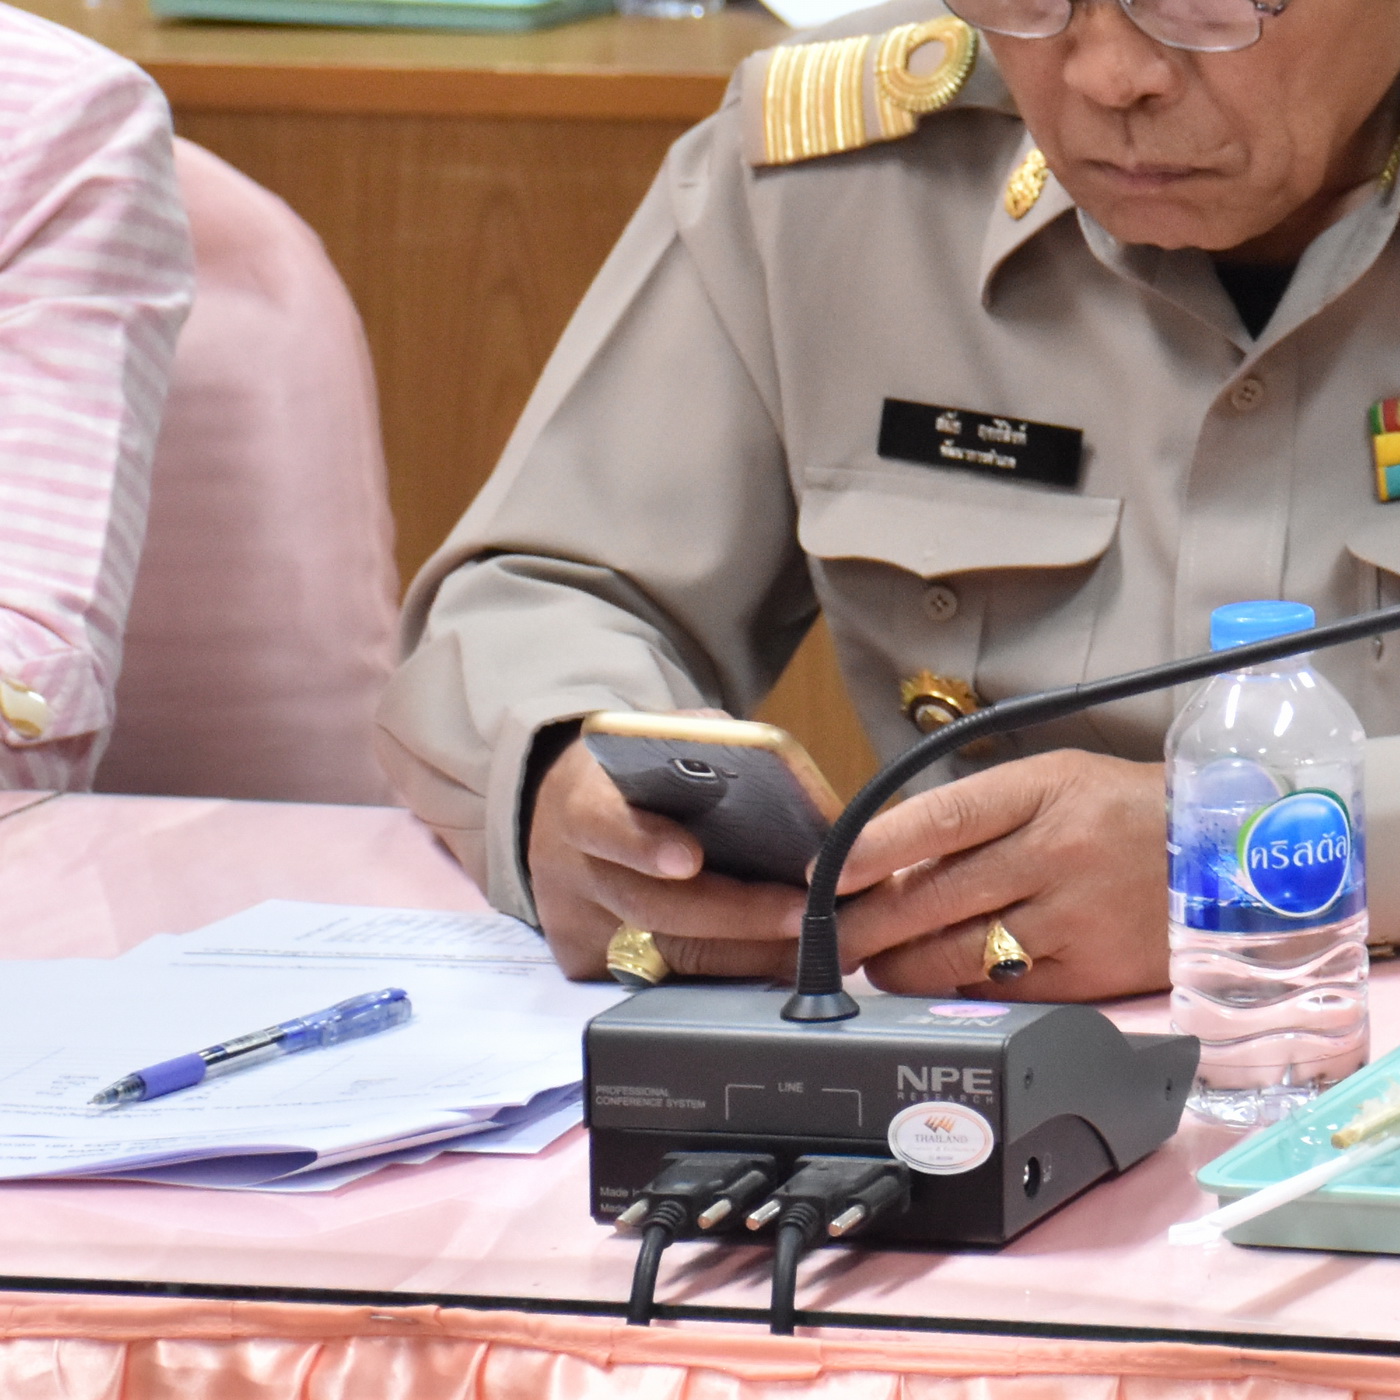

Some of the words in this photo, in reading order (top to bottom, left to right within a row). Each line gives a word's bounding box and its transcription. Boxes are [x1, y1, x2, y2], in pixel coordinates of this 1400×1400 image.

[1250, 830, 1347, 870] คริสตัล
[896, 1064, 993, 1095] NPE
[595, 1085, 669, 1097] PROFESSIONAL
[777, 1082, 804, 1094] LINE
[595, 1096, 663, 1107] CONFERENCE
[667, 1099, 706, 1109] SYSTEM
[896, 1091, 994, 1104] RESEARCH
[914, 1133, 968, 1144] THAILAND
